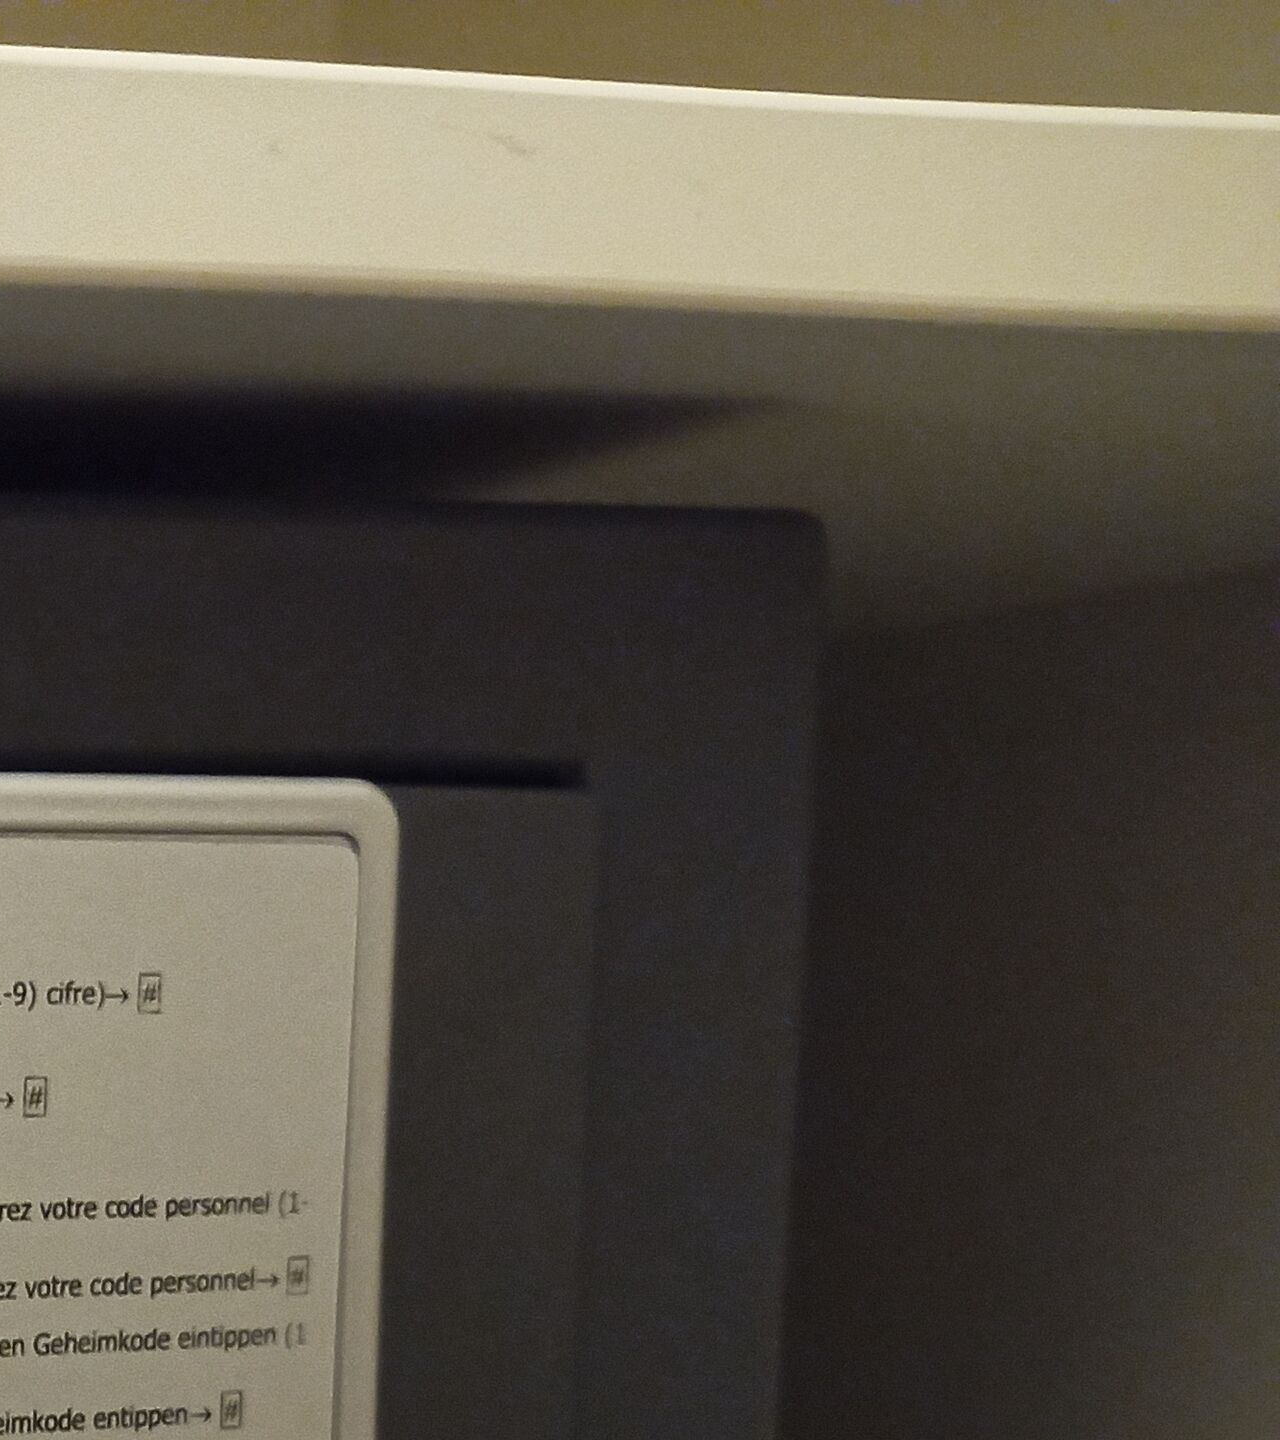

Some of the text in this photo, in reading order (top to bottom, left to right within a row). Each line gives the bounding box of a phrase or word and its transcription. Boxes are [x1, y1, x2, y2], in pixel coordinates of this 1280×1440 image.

[39, 1197, 98, 1221] votre
[104, 1194, 158, 1219] code
[165, 1192, 270, 1222] personnel
[24, 1275, 83, 1300] votre
[89, 1271, 143, 1297] code
[150, 1267, 256, 1300] personnel
[32, 1328, 172, 1357] Geheimkode
[177, 1326, 277, 1352] eintippen
[93, 1407, 188, 1433] entippen
